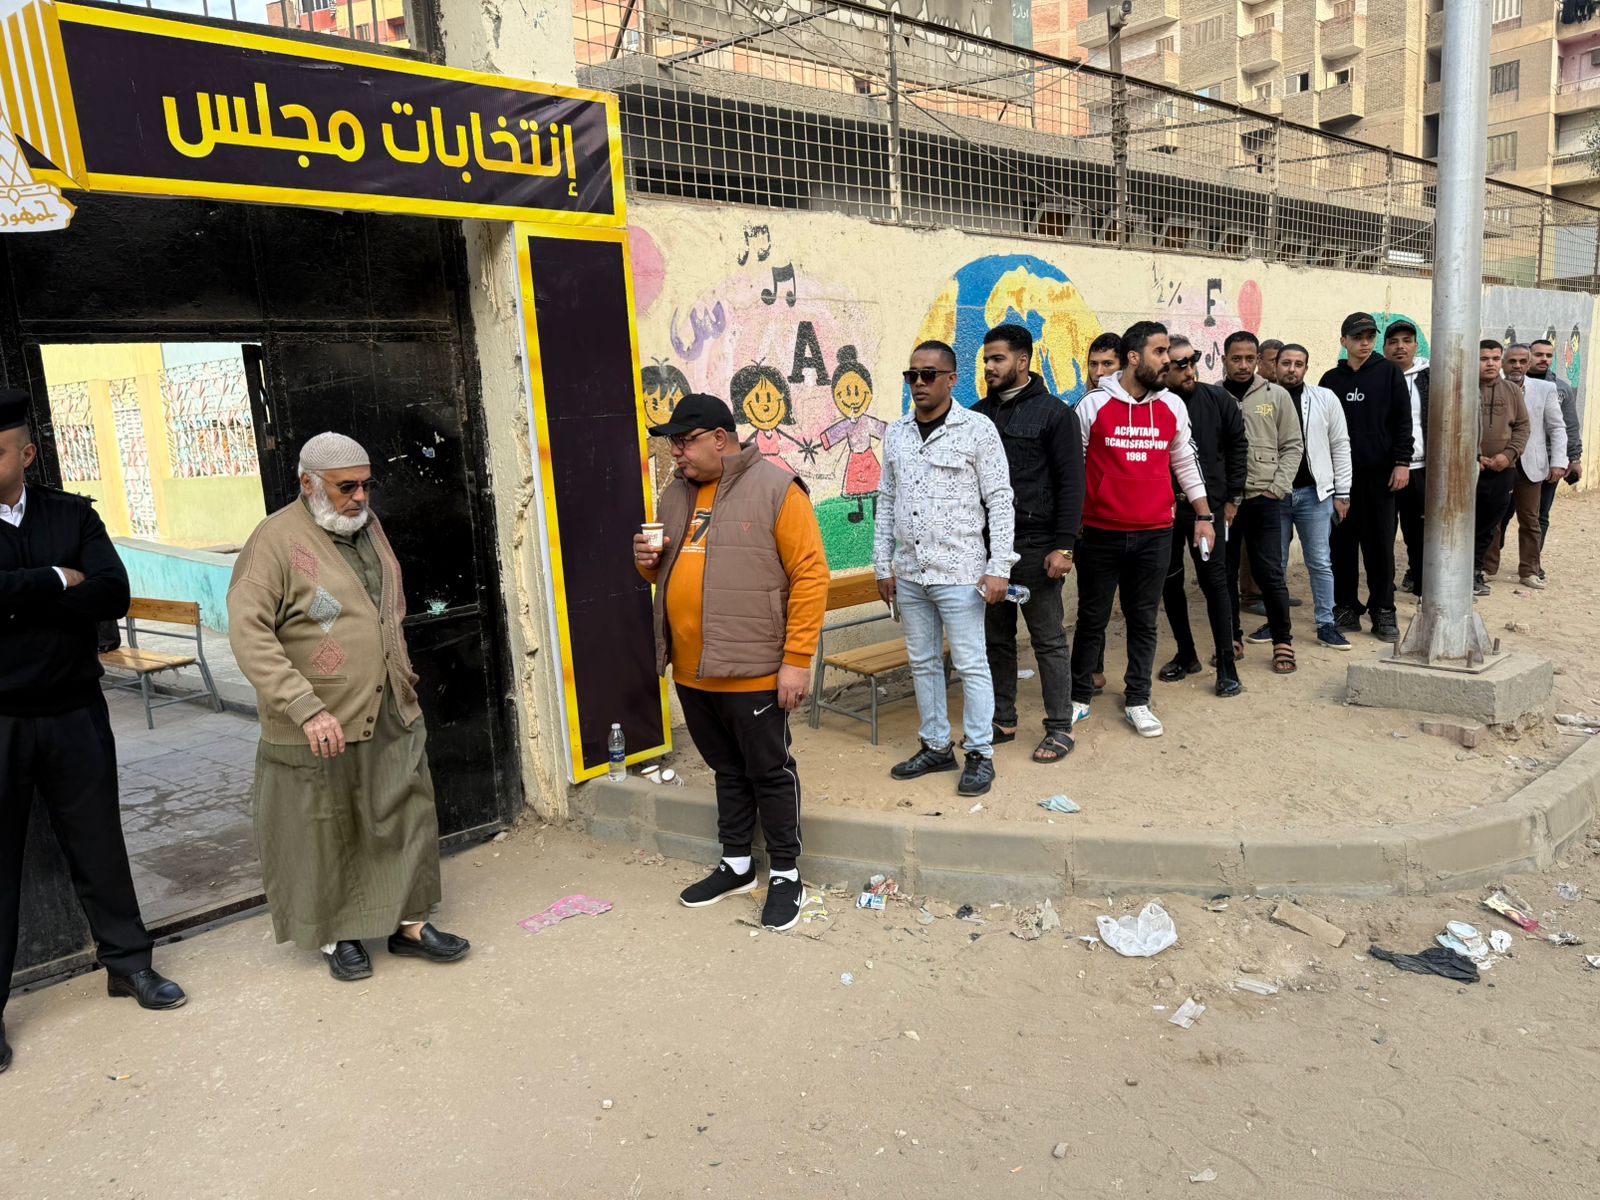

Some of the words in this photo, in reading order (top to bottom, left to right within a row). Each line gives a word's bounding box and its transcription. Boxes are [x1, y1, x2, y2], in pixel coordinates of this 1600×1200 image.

[162, 82, 366, 168] مجلس
[381, 101, 578, 197] إنتخابات
[0, 200, 58, 226] جمهور
[787, 321, 832, 386] A
[1346, 388, 1365, 402] alo
[1126, 451, 1147, 462] 1988
